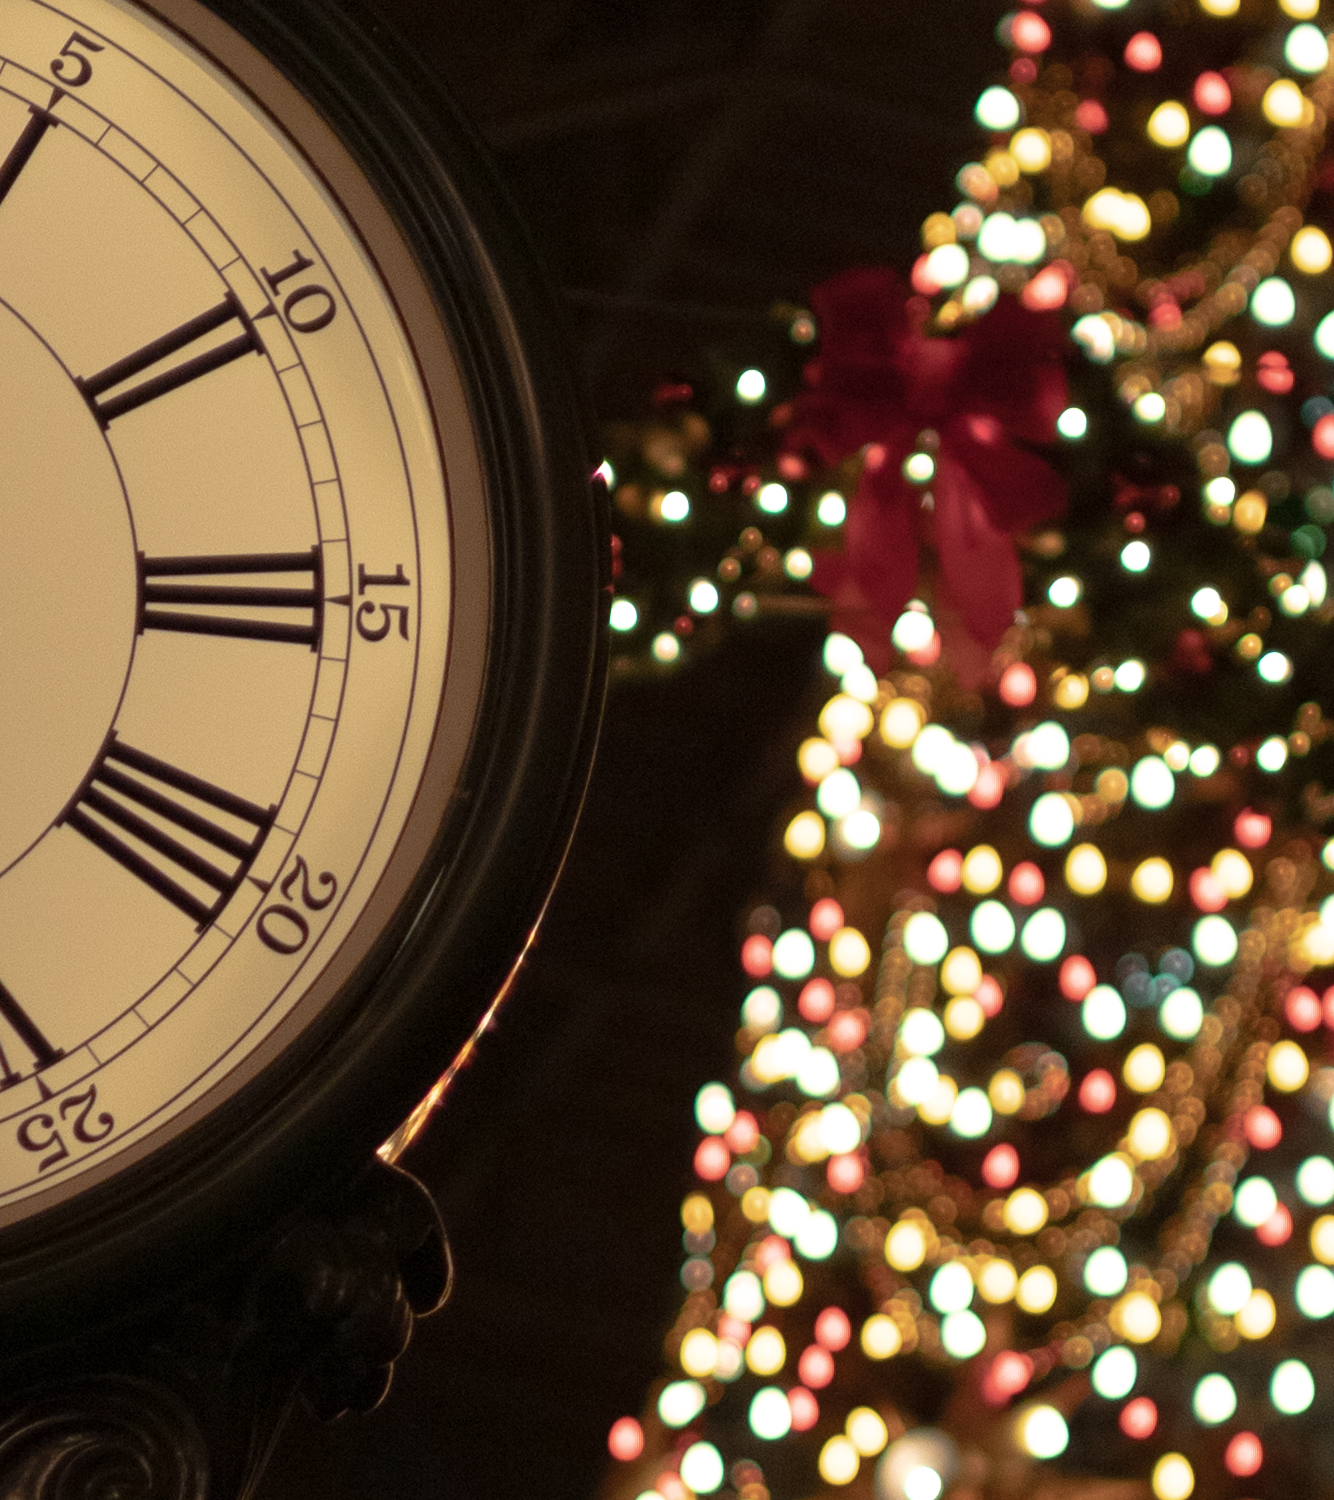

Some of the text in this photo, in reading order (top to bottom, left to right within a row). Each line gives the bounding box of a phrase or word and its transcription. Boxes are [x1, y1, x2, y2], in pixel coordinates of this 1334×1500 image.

[48, 29, 107, 89] 5
[258, 247, 339, 336] 10
[76, 292, 267, 429] II
[135, 546, 325, 652] III
[354, 561, 412, 644] 15
[55, 730, 279, 935] IIII
[254, 853, 339, 957] 20
[15, 1082, 116, 1175] 25
